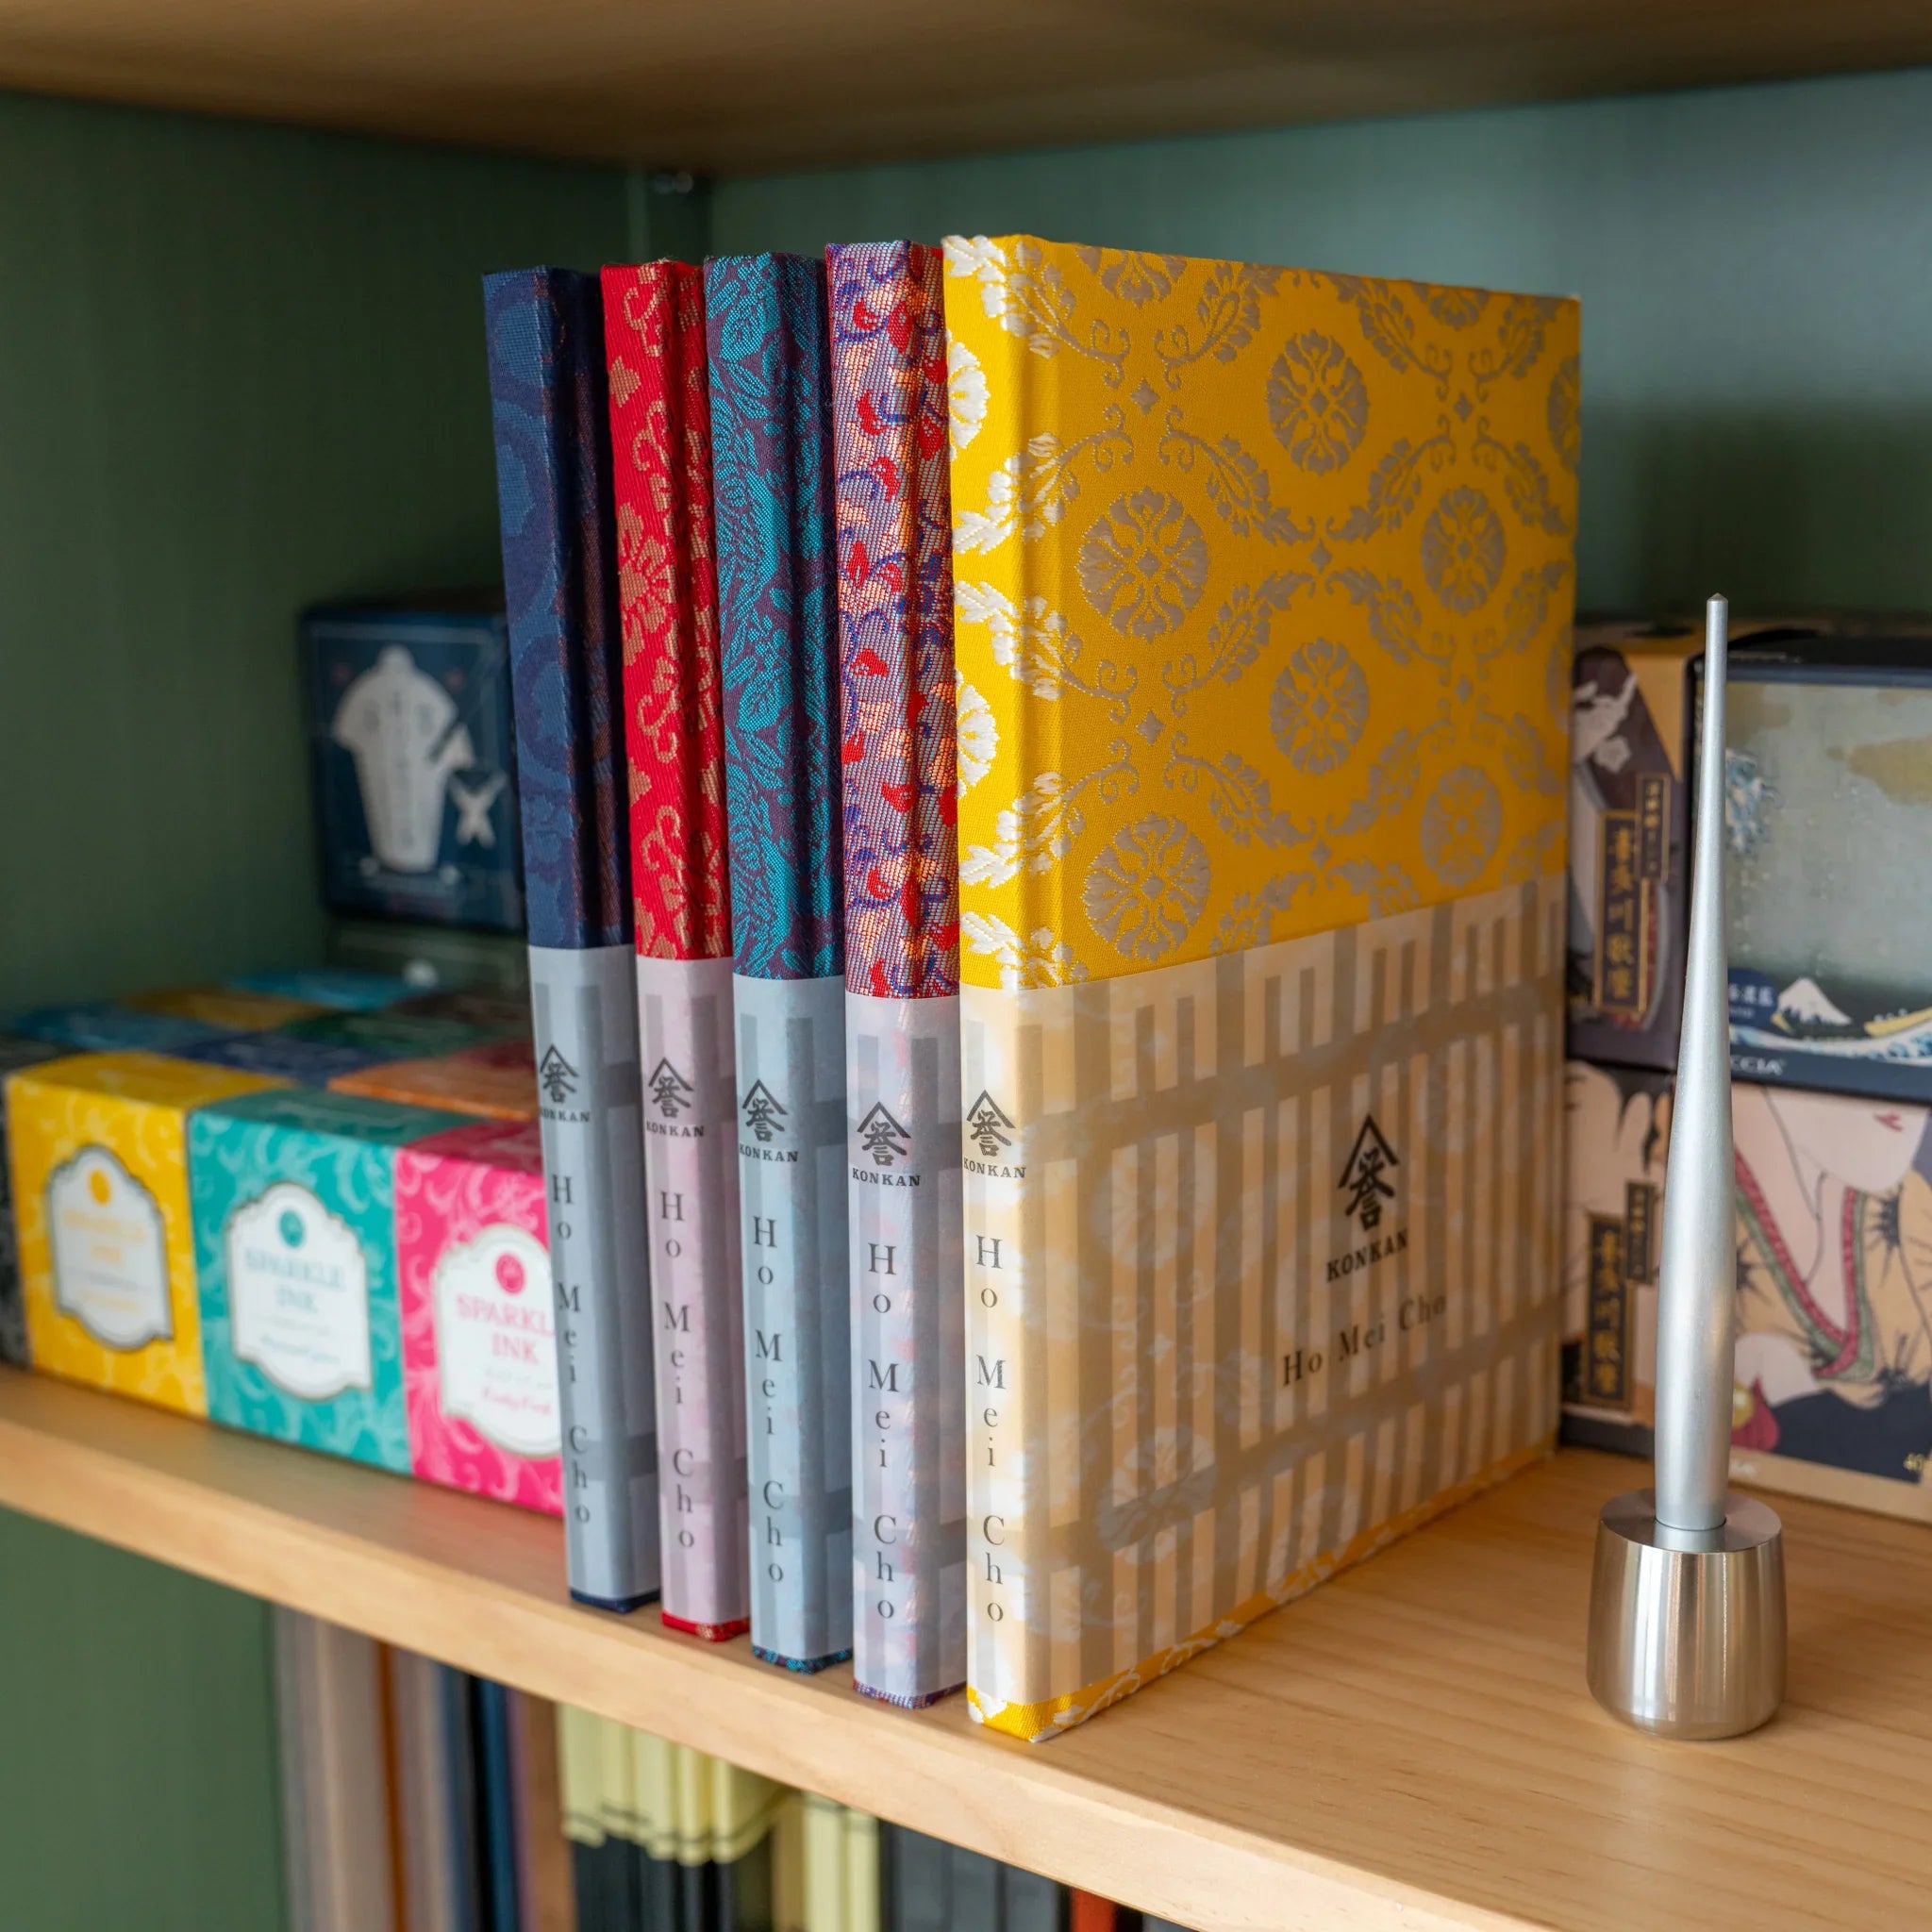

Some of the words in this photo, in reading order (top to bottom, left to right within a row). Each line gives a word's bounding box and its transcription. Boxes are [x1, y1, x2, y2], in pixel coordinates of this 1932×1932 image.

[646, 1120, 705, 1138] KONKAN
[739, 1142, 799, 1163] KONKAN
[852, 1167, 921, 1187] KONKAN
[963, 1157, 1027, 1178] KONKAN
[552, 1174, 574, 1241] Ho
[660, 1191, 685, 1258] Ho
[753, 1215, 777, 1285] Ho
[868, 1242, 897, 1314] Ho
[974, 1235, 1003, 1308] Ho
[1325, 1228, 1408, 1283] KONKAN
[457, 1292, 556, 1339] SPARKL
[491, 1332, 541, 1366] INK
[558, 1281, 582, 1383] Mei
[1282, 1349, 1323, 1388] Ho
[1338, 1314, 1386, 1362] Mei
[1397, 1293, 1448, 1332] Cho
[664, 1301, 691, 1405] Mei
[755, 1328, 783, 1435] Mei
[868, 1358, 900, 1468] Mei
[975, 1354, 1007, 1467] Mei
[568, 1425, 591, 1524] Cho
[673, 1447, 695, 1548] Cho
[763, 1480, 785, 1583] Cho
[874, 1514, 897, 1619] Cho
[983, 1514, 1005, 1623] Cho
